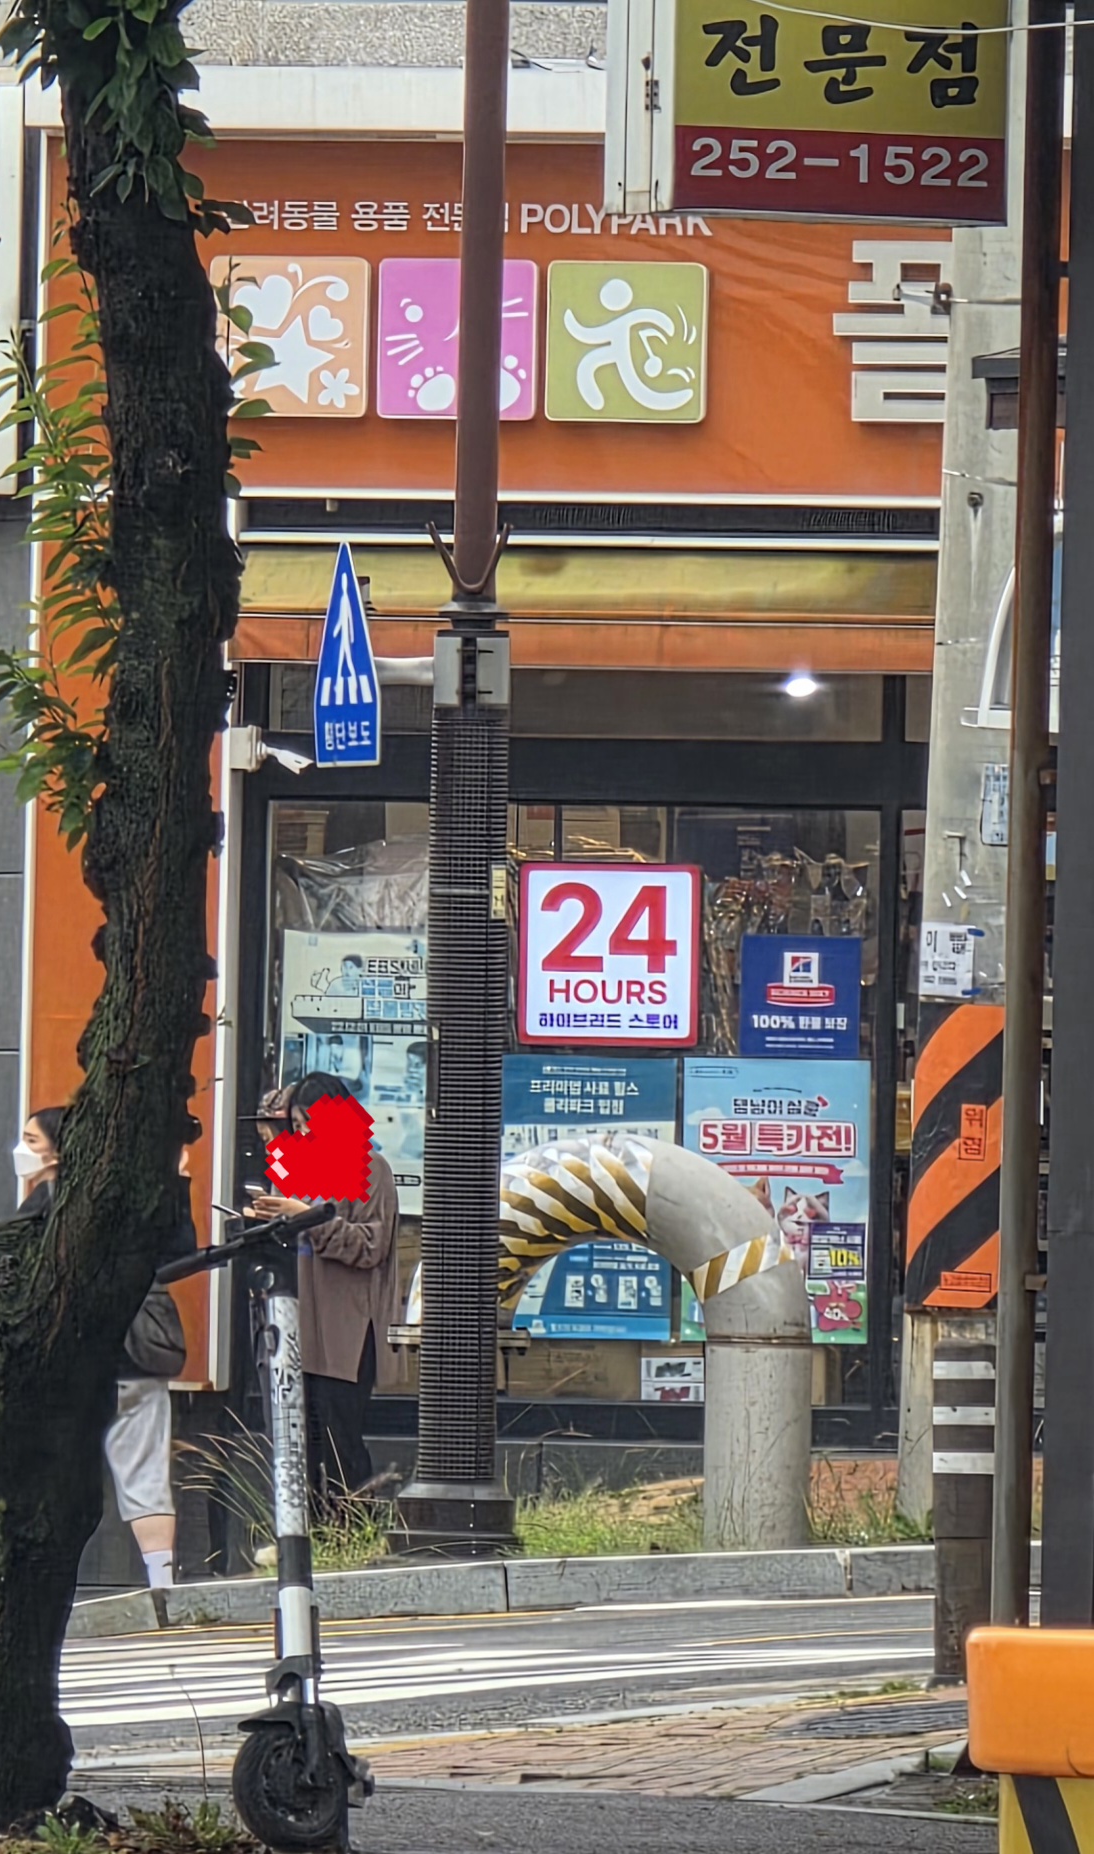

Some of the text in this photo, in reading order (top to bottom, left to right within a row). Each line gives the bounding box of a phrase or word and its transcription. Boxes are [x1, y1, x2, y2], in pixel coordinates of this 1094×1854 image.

[702, 14, 980, 108] 전문점
[691, 137, 989, 188] 252-1522
[351, 201, 411, 232] 용품
[521, 203, 713, 236] POLYPARK
[541, 882, 677, 974] 24
[549, 979, 667, 1004] HOURS
[628, 1013, 678, 1030] 스토어
[752, 1014, 796, 1029] 100%
[530, 1080, 581, 1096] 프리미엄
[702, 1123, 851, 1153] 5월 특가전!
